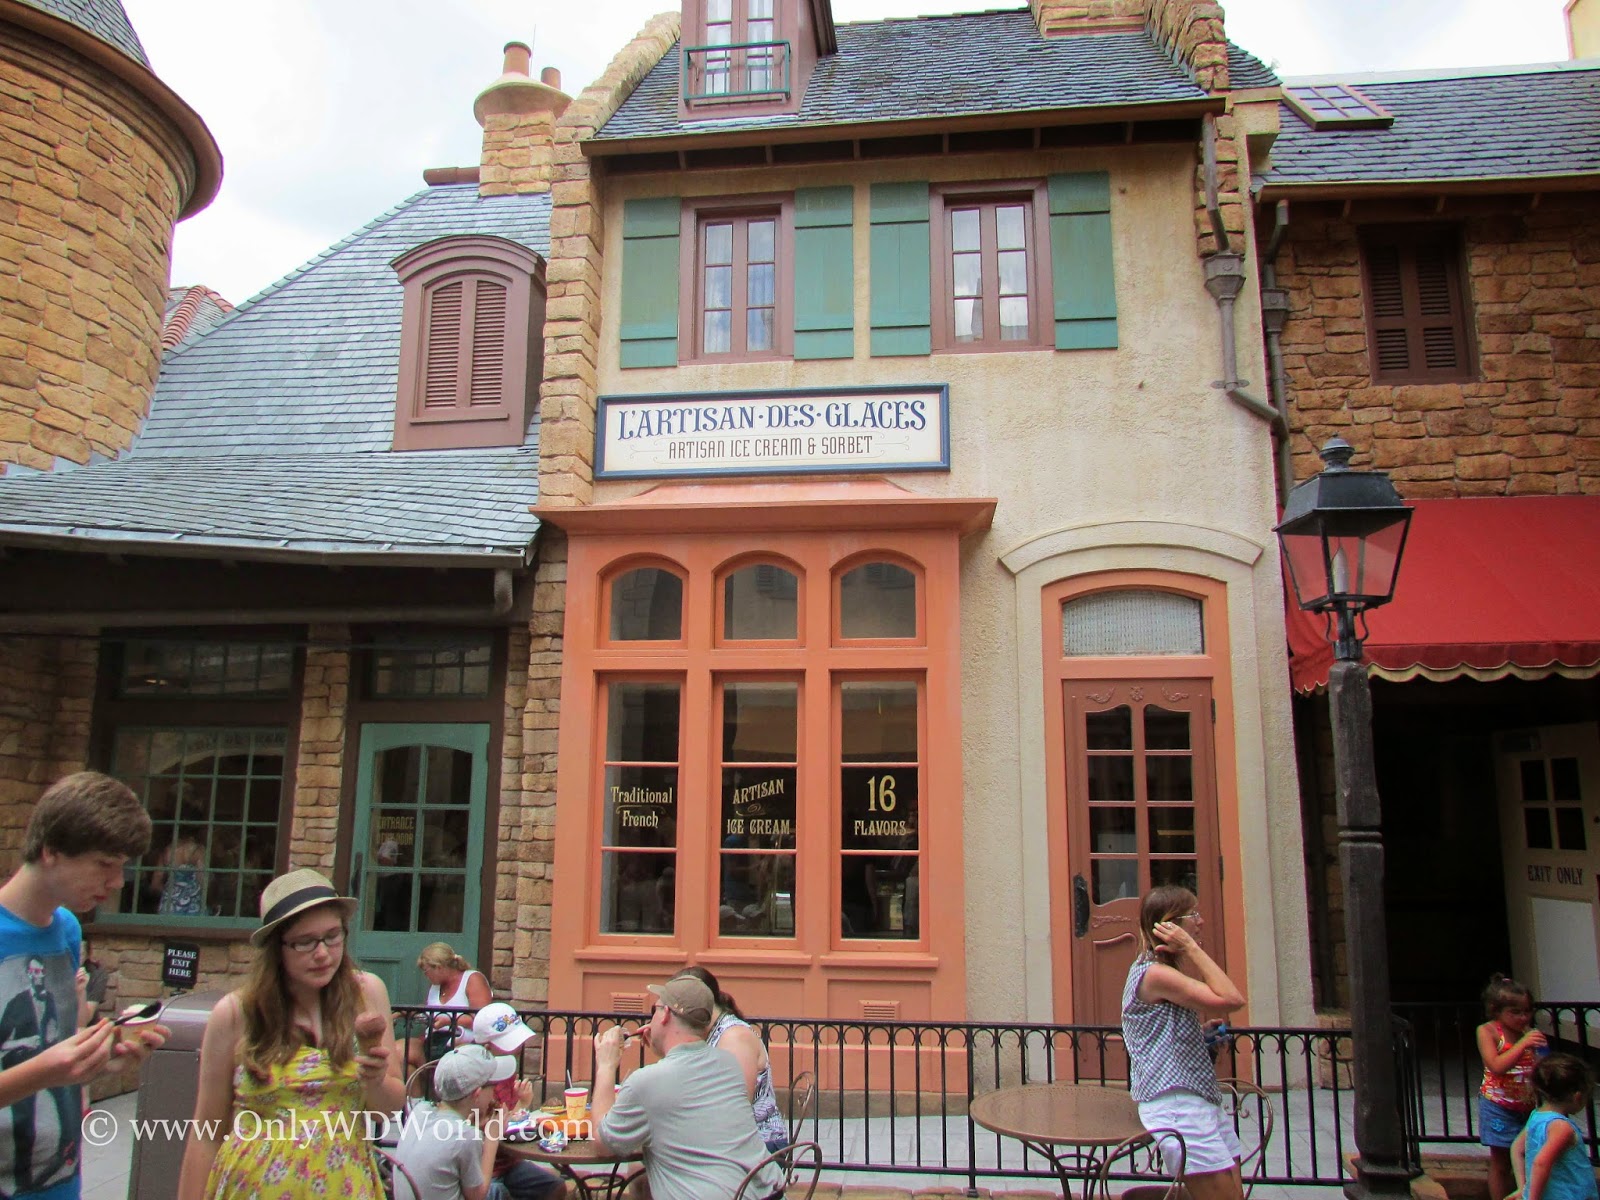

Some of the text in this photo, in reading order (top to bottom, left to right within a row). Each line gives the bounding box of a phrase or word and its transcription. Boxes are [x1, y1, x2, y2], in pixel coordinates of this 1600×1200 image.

[825, 400, 926, 430] GLACES
[669, 435, 873, 459] ARTISAN ICE CREAM & SORBET
[610, 785, 673, 804] Traditional
[732, 778, 784, 805] ARTISAN
[867, 774, 896, 812] 16
[622, 810, 659, 828] French
[727, 819, 790, 835] ICE CREAM
[854, 820, 906, 836] FLAVORS
[1528, 865, 1583, 885] EXIT ONLY
[167, 948, 197, 959] PLEASE
[171, 959, 191, 968] EXIT
[168, 968, 192, 978] HERE
